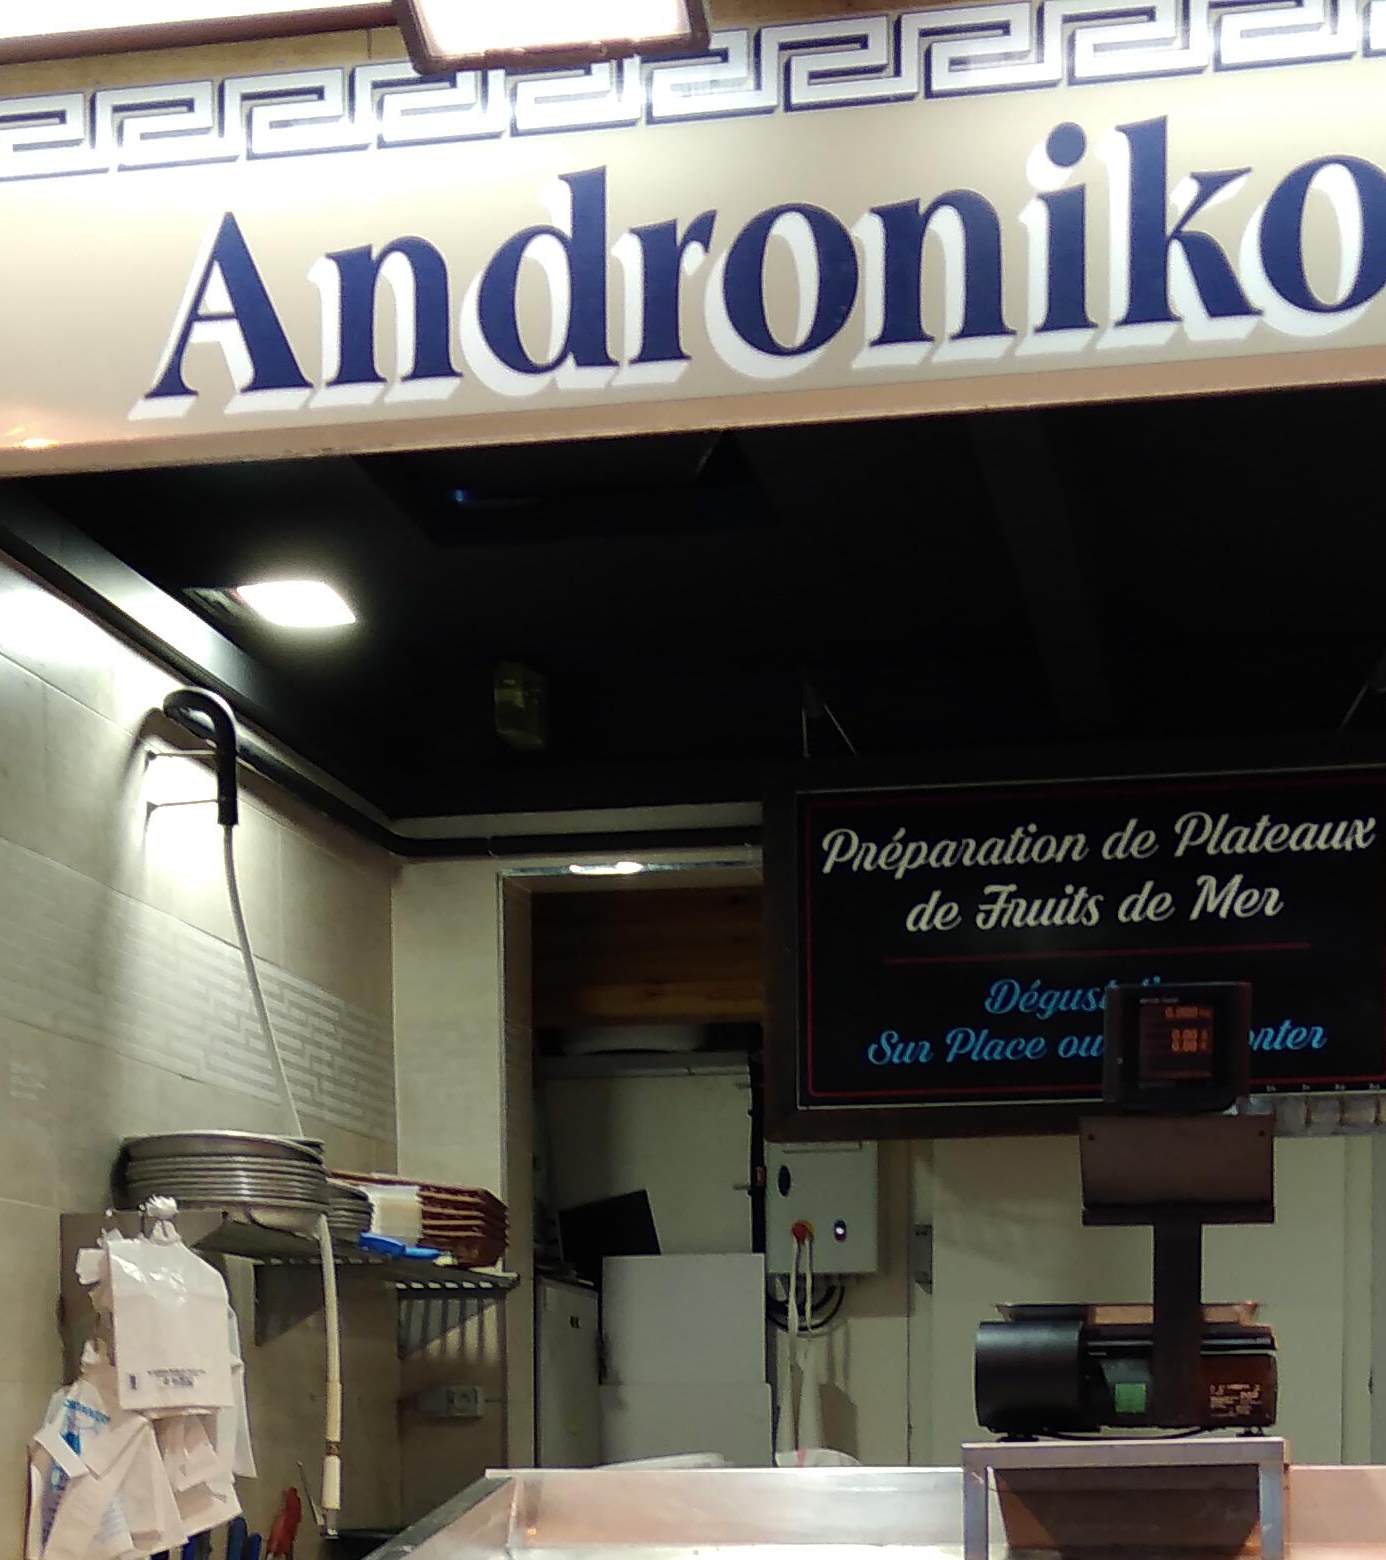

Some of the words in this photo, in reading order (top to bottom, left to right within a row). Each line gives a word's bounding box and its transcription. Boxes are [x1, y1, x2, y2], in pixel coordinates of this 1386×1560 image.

[821, 823, 1090, 880] Préparation
[1102, 817, 1160, 860] de
[1175, 810, 1378, 856] Plateaux
[906, 889, 963, 933] de
[975, 884, 1104, 929] Fruits
[1117, 880, 1176, 923] de
[1189, 874, 1285, 918] Mer
[867, 1029, 934, 1065] Sur
[945, 1026, 1046, 1061] Place
